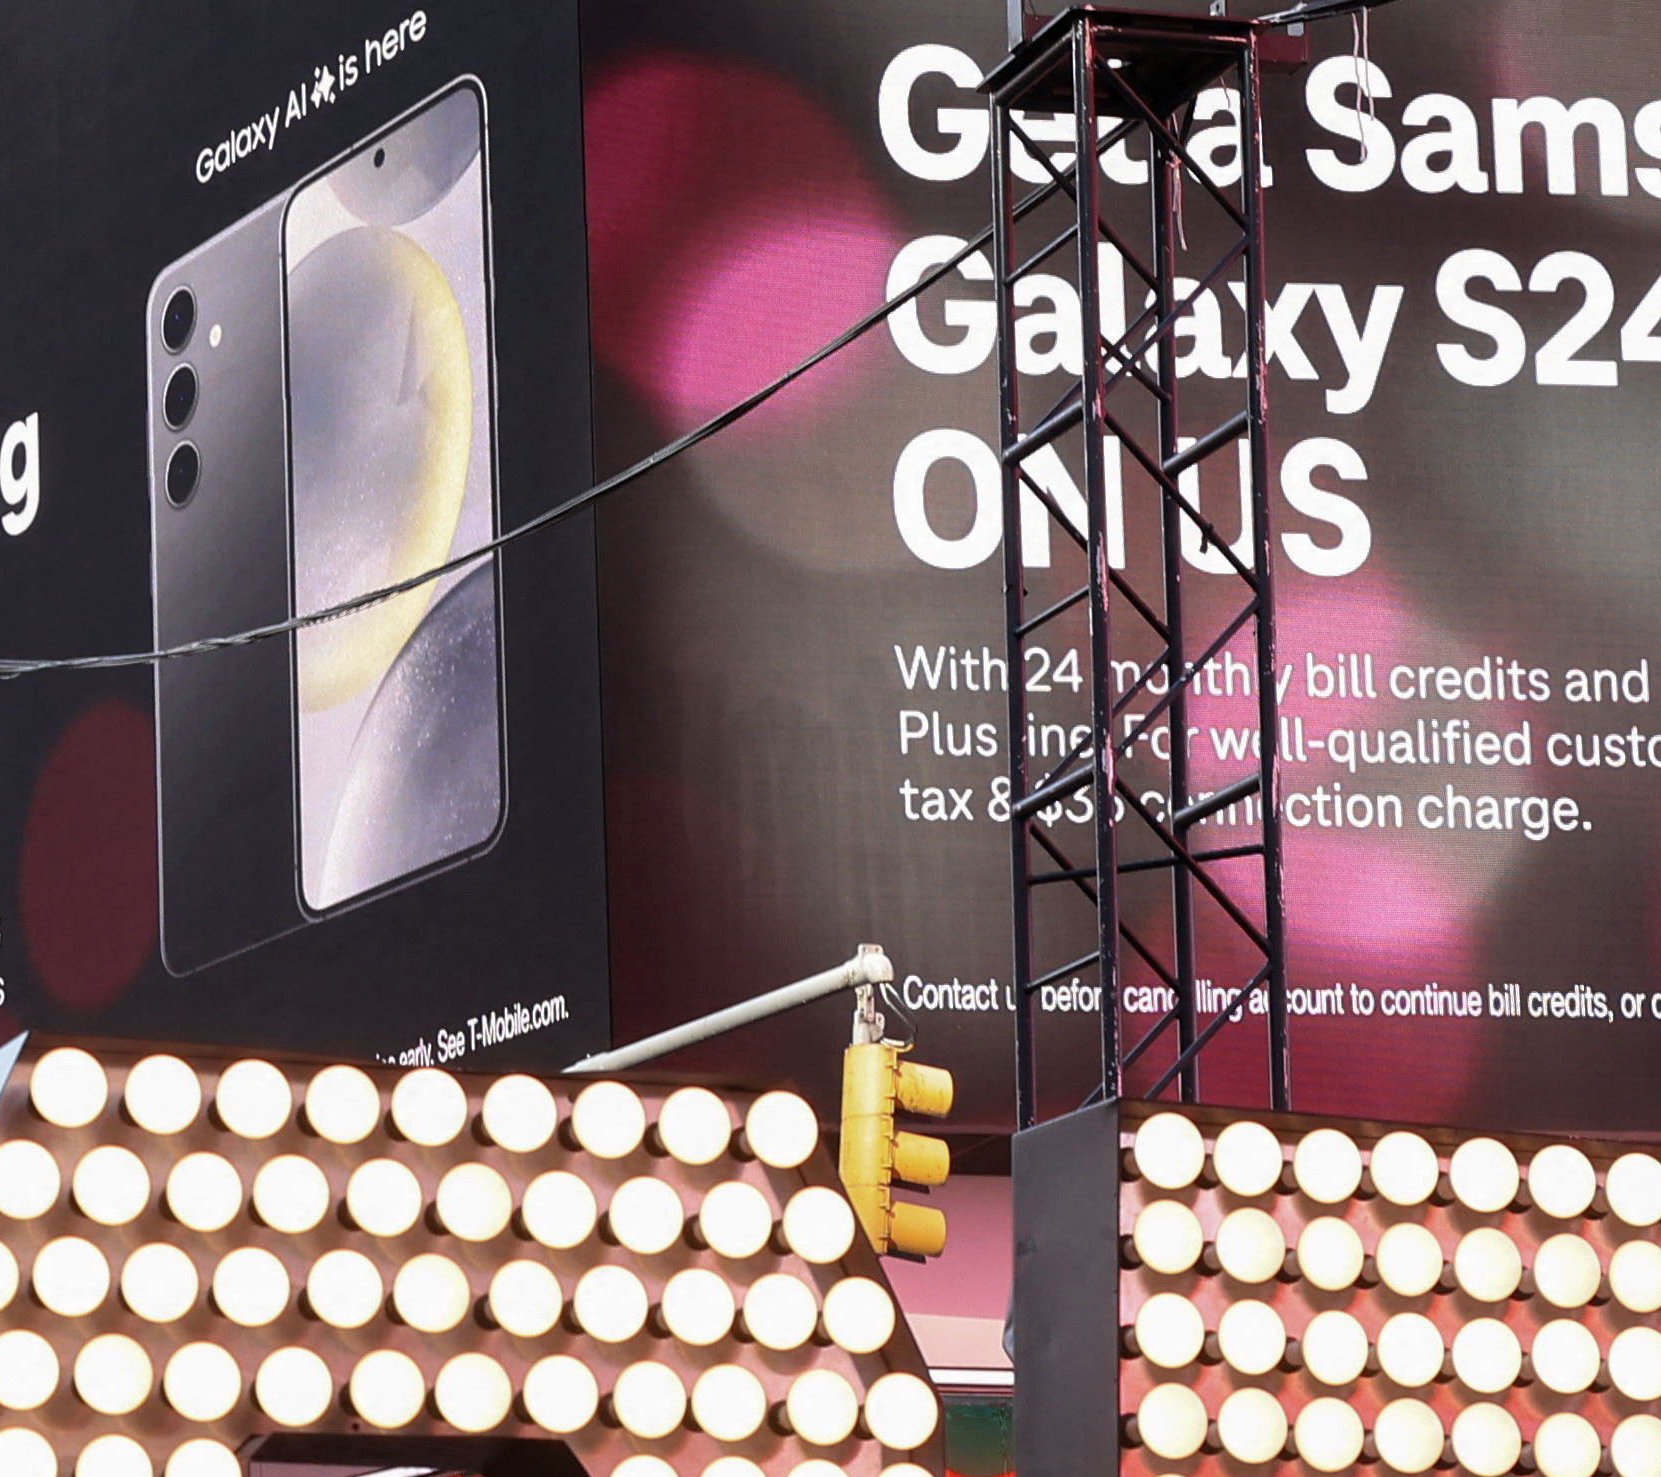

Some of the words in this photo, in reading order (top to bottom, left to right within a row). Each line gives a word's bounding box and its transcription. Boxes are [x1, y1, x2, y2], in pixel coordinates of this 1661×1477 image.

[196, 106, 280, 184] Galaxy
[284, 82, 307, 128] AI
[338, 54, 359, 91] is
[365, 10, 427, 74] here
[886, 234, 1405, 416] Galaxy
[893, 428, 1126, 570] ON
[1178, 436, 1372, 578] US
[893, 644, 1009, 692] With
[1024, 648, 1084, 693] 24
[1305, 652, 1377, 702] bill
[1389, 656, 1551, 703] credits
[1564, 658, 1649, 705] and
[898, 710, 999, 757] Plus
[899, 777, 974, 822] tax
[1416, 784, 1594, 841] charge.
[437, 1008, 466, 1064] See
[467, 994, 570, 1052] T-Mobile.com.
[902, 975, 1000, 1011] Contact
[1042, 982, 1102, 1012] befor
[1350, 983, 1375, 1015] to
[1380, 983, 1483, 1017] continue
[1488, 983, 1521, 1018] bill
[1527, 985, 1614, 1023] credits,
[1620, 994, 1644, 1019] or
